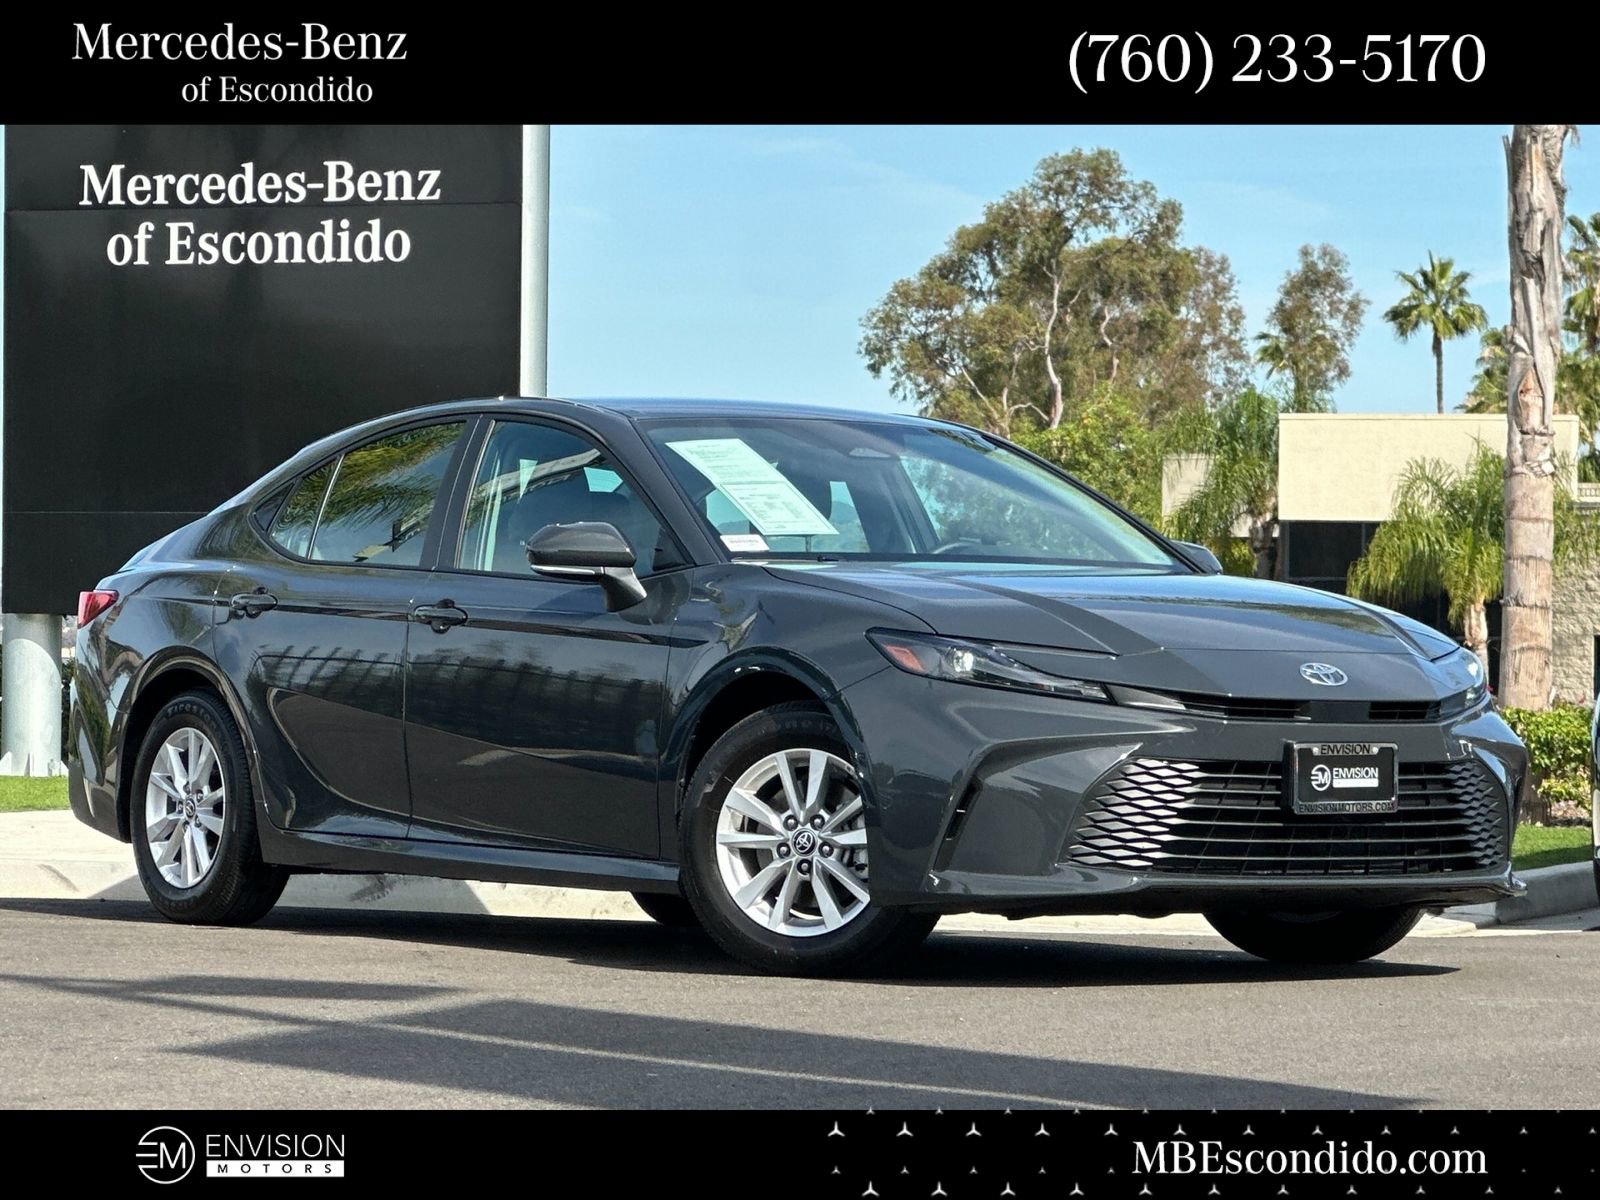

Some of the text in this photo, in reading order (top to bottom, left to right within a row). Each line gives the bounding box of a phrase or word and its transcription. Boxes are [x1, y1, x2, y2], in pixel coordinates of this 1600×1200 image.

[79, 160, 441, 206] Mercedes-Benz
[106, 218, 411, 266] of Escondido
[1320, 744, 1371, 755] ENVISION
[1333, 767, 1379, 779] ENVISION
